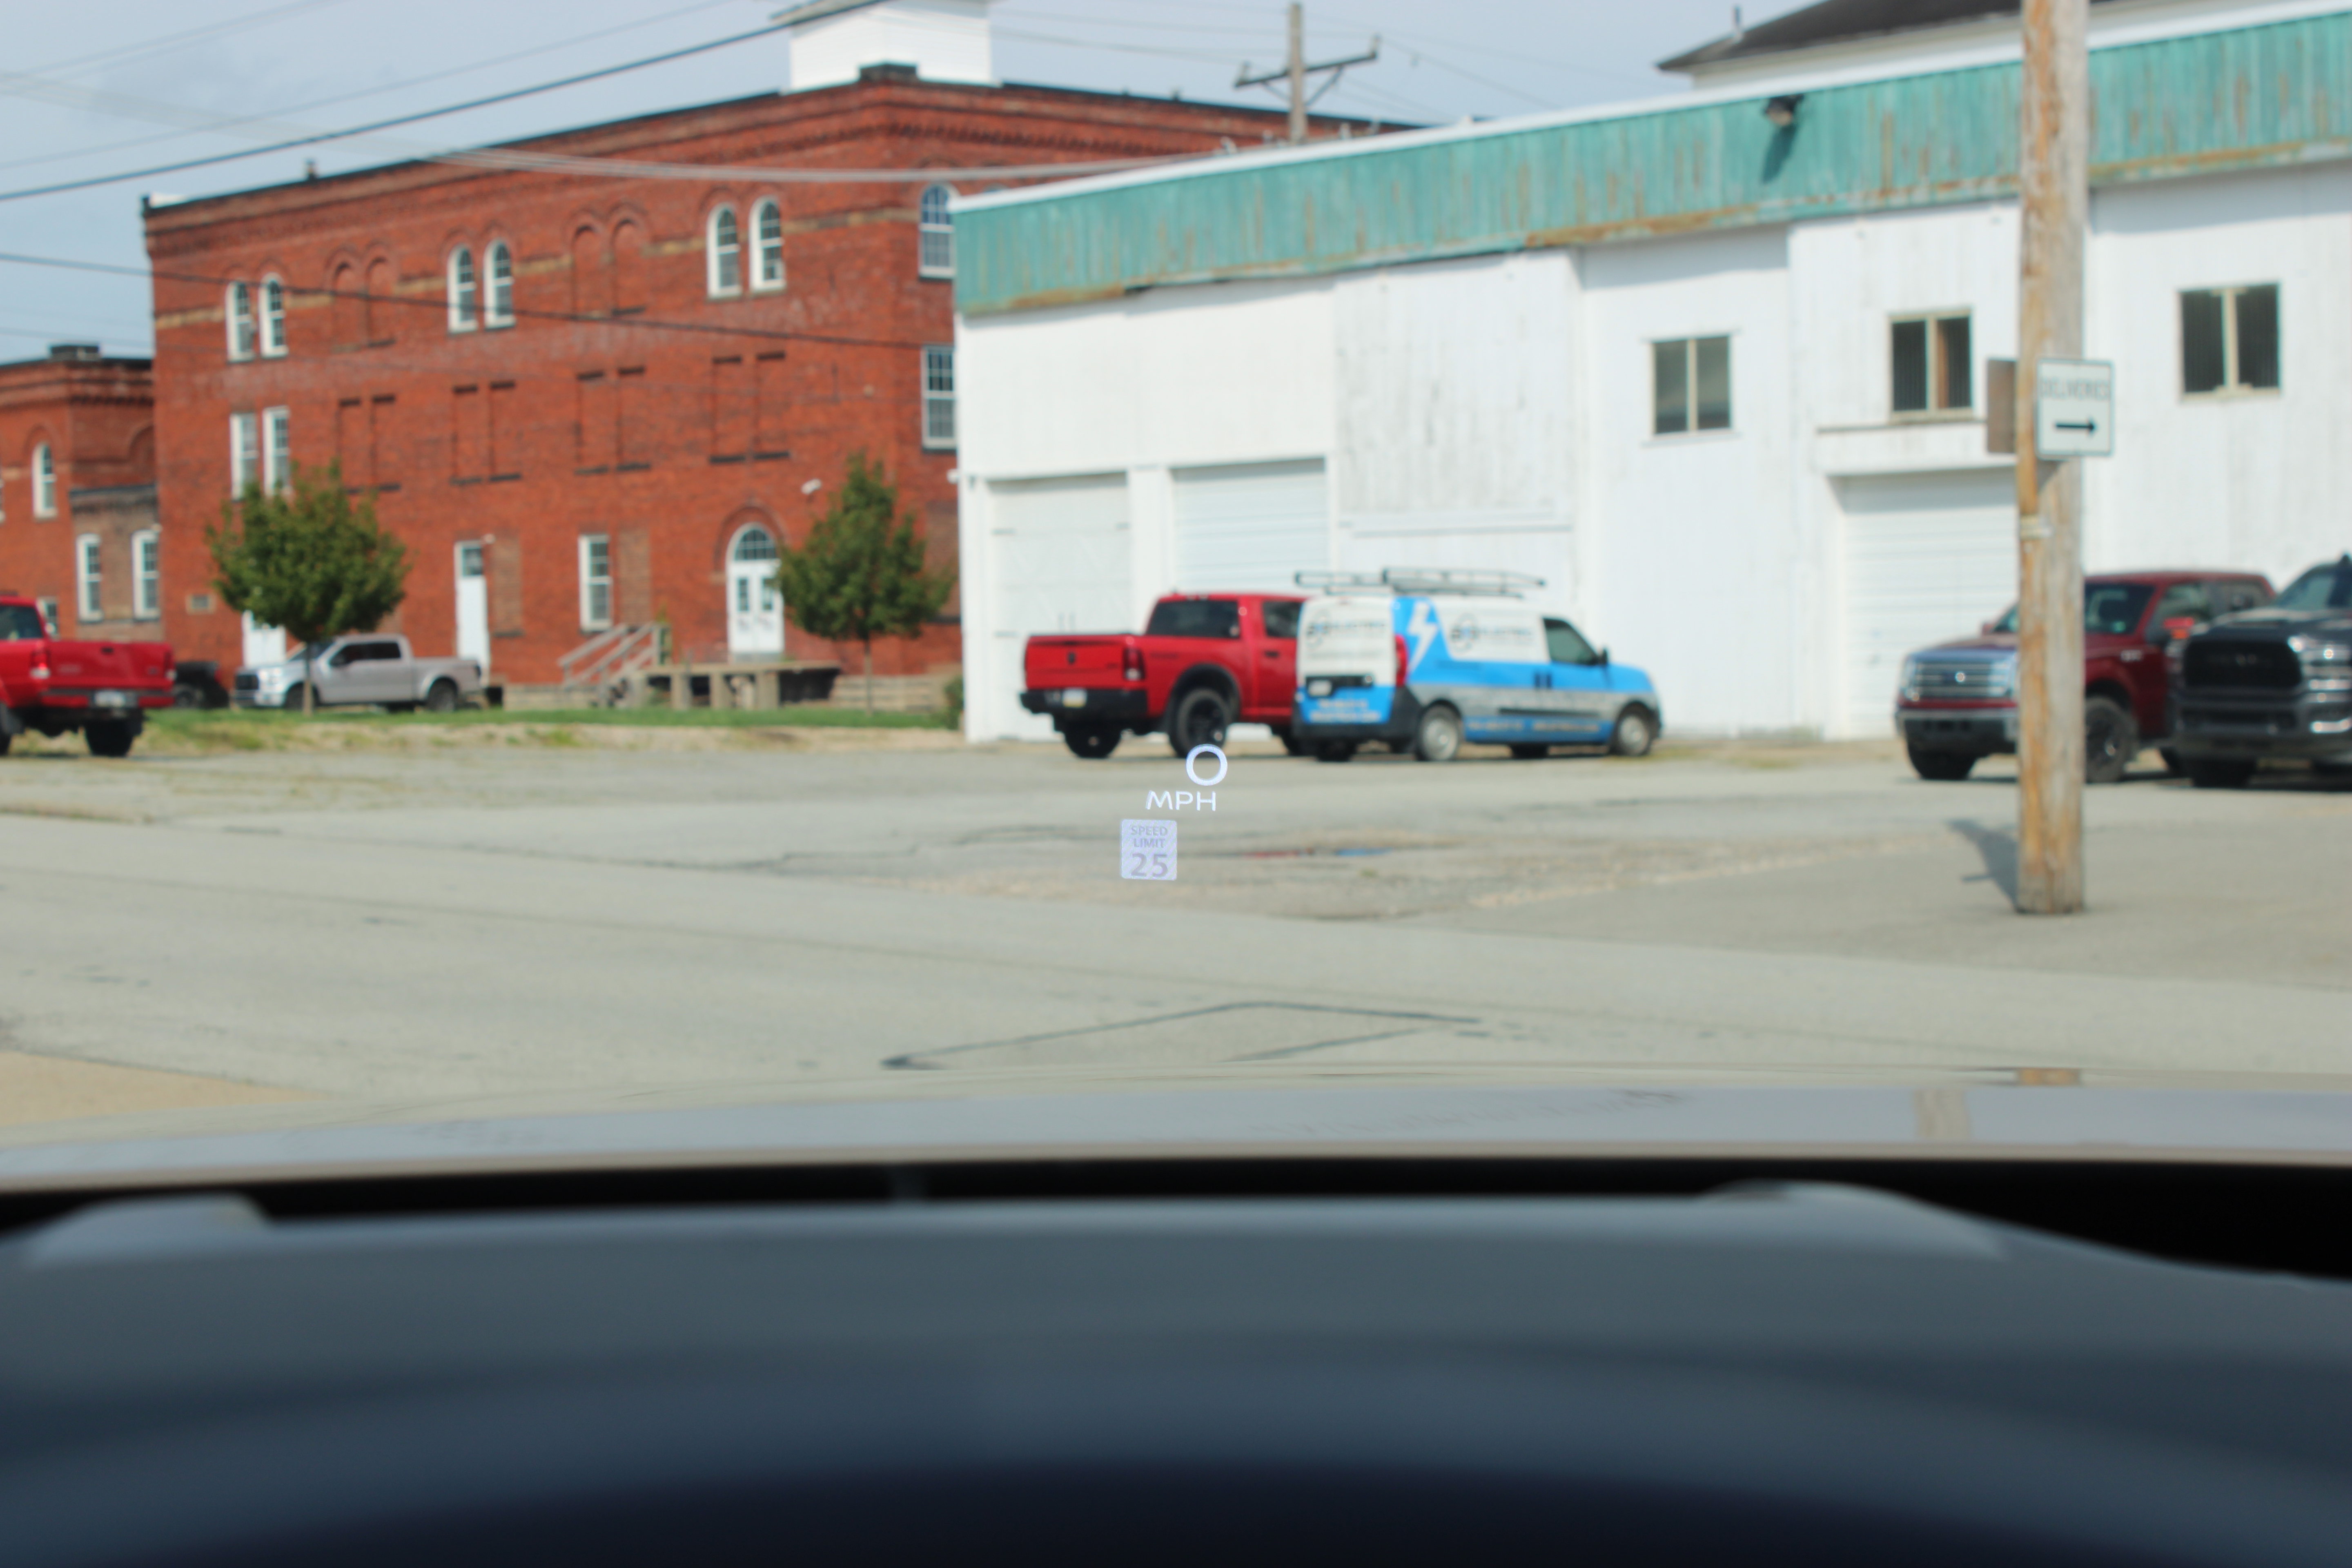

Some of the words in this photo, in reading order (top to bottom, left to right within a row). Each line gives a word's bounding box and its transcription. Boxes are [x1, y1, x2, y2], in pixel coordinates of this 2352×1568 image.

[1146, 790, 1216, 811] MPH
[1131, 826, 1168, 836] SPEED
[1134, 838, 1166, 848] LIMIT
[1131, 853, 1168, 878] 25
